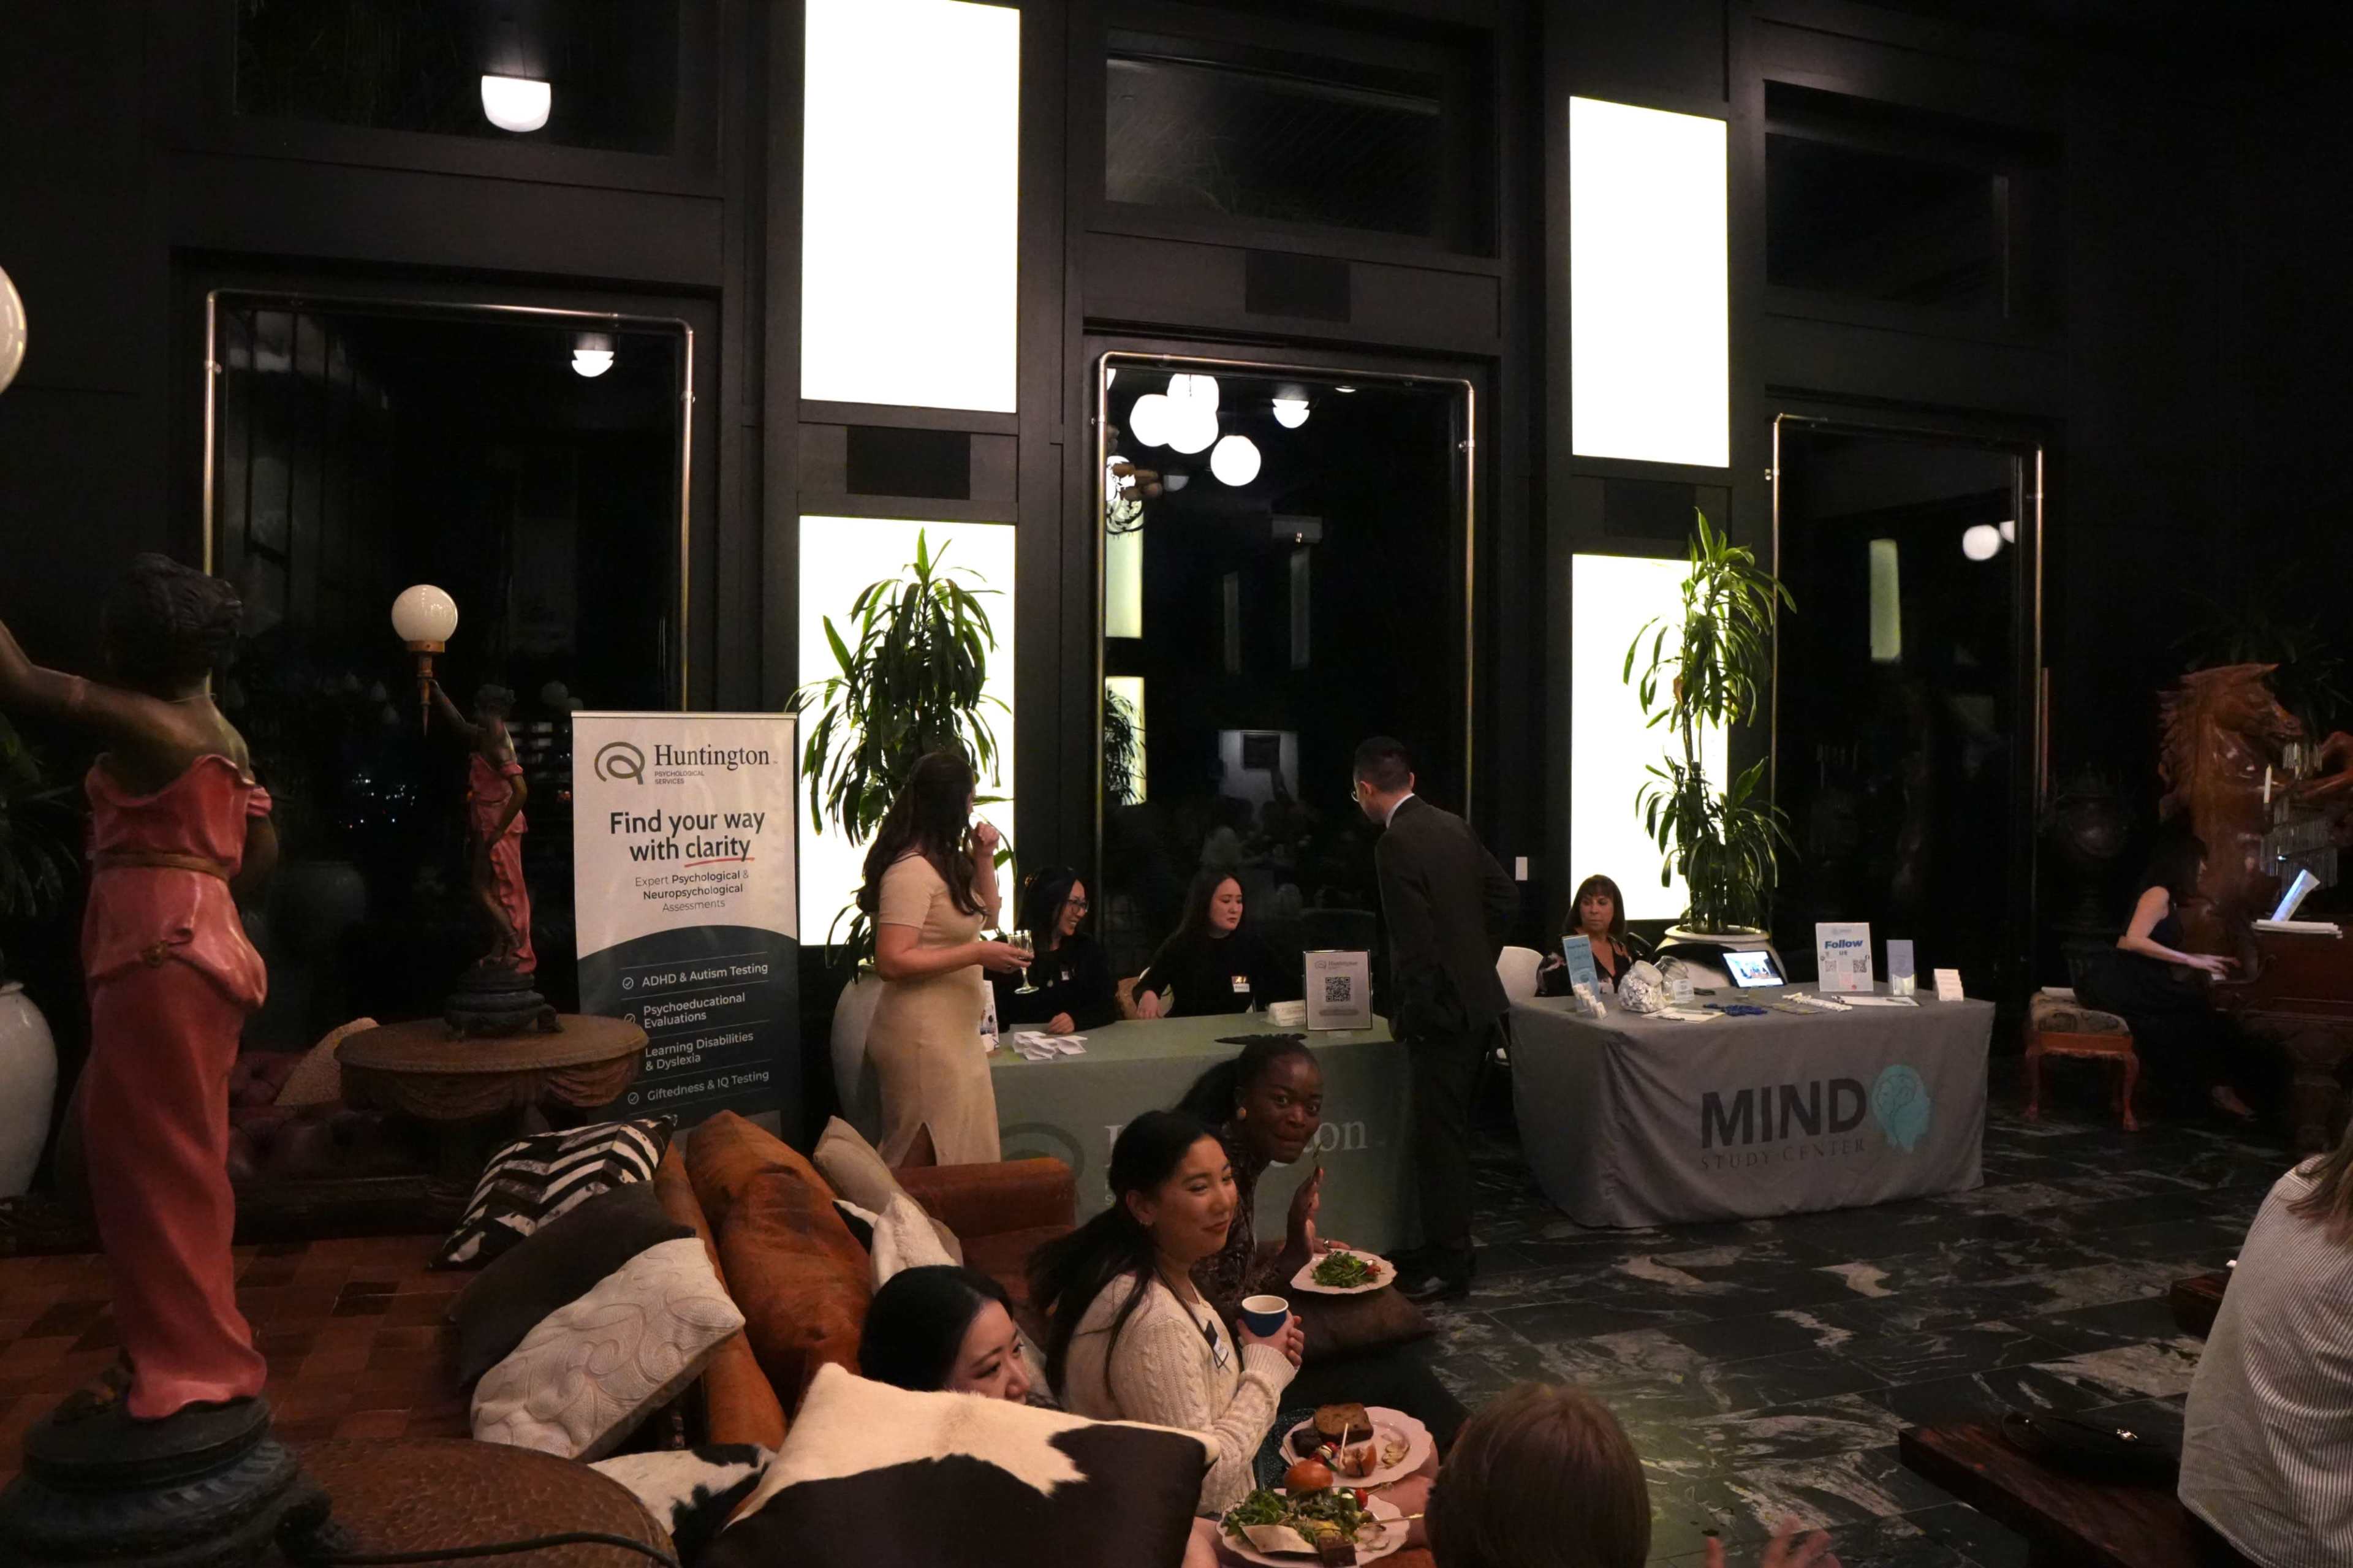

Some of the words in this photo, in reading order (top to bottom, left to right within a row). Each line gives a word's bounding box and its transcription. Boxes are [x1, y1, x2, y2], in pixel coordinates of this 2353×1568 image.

[654, 744, 770, 770] Huntington
[610, 809, 662, 834] Find
[669, 812, 718, 838] your
[724, 811, 765, 834] way
[629, 836, 679, 862] with
[685, 835, 751, 862] clarity
[635, 876, 669, 888] Expert
[672, 870, 740, 886] Psychological
[742, 869, 749, 879] &
[643, 884, 743, 900] Neuropsychological
[662, 898, 726, 912] Assessments
[1825, 939, 1863, 950] Follow
[642, 974, 676, 988] ADHD
[680, 972, 688, 983] &
[689, 967, 727, 980] Autism
[730, 963, 769, 978] Testing
[643, 992, 745, 1017] Psychoeducational
[644, 1012, 707, 1029] Evaluations
[645, 1041, 694, 1058] Learning
[696, 1031, 754, 1050] Disabilities
[645, 1061, 654, 1072] &
[656, 1053, 702, 1070] Dyslexia
[648, 1083, 705, 1102] Giftedness
[707, 1080, 716, 1090] &
[718, 1076, 729, 1089] IQ
[732, 1070, 770, 1086] Testing
[1702, 1078, 1867, 1149] MIND
[1701, 1151, 1771, 1170] STUDY
[1783, 1138, 1865, 1162] CENTER
